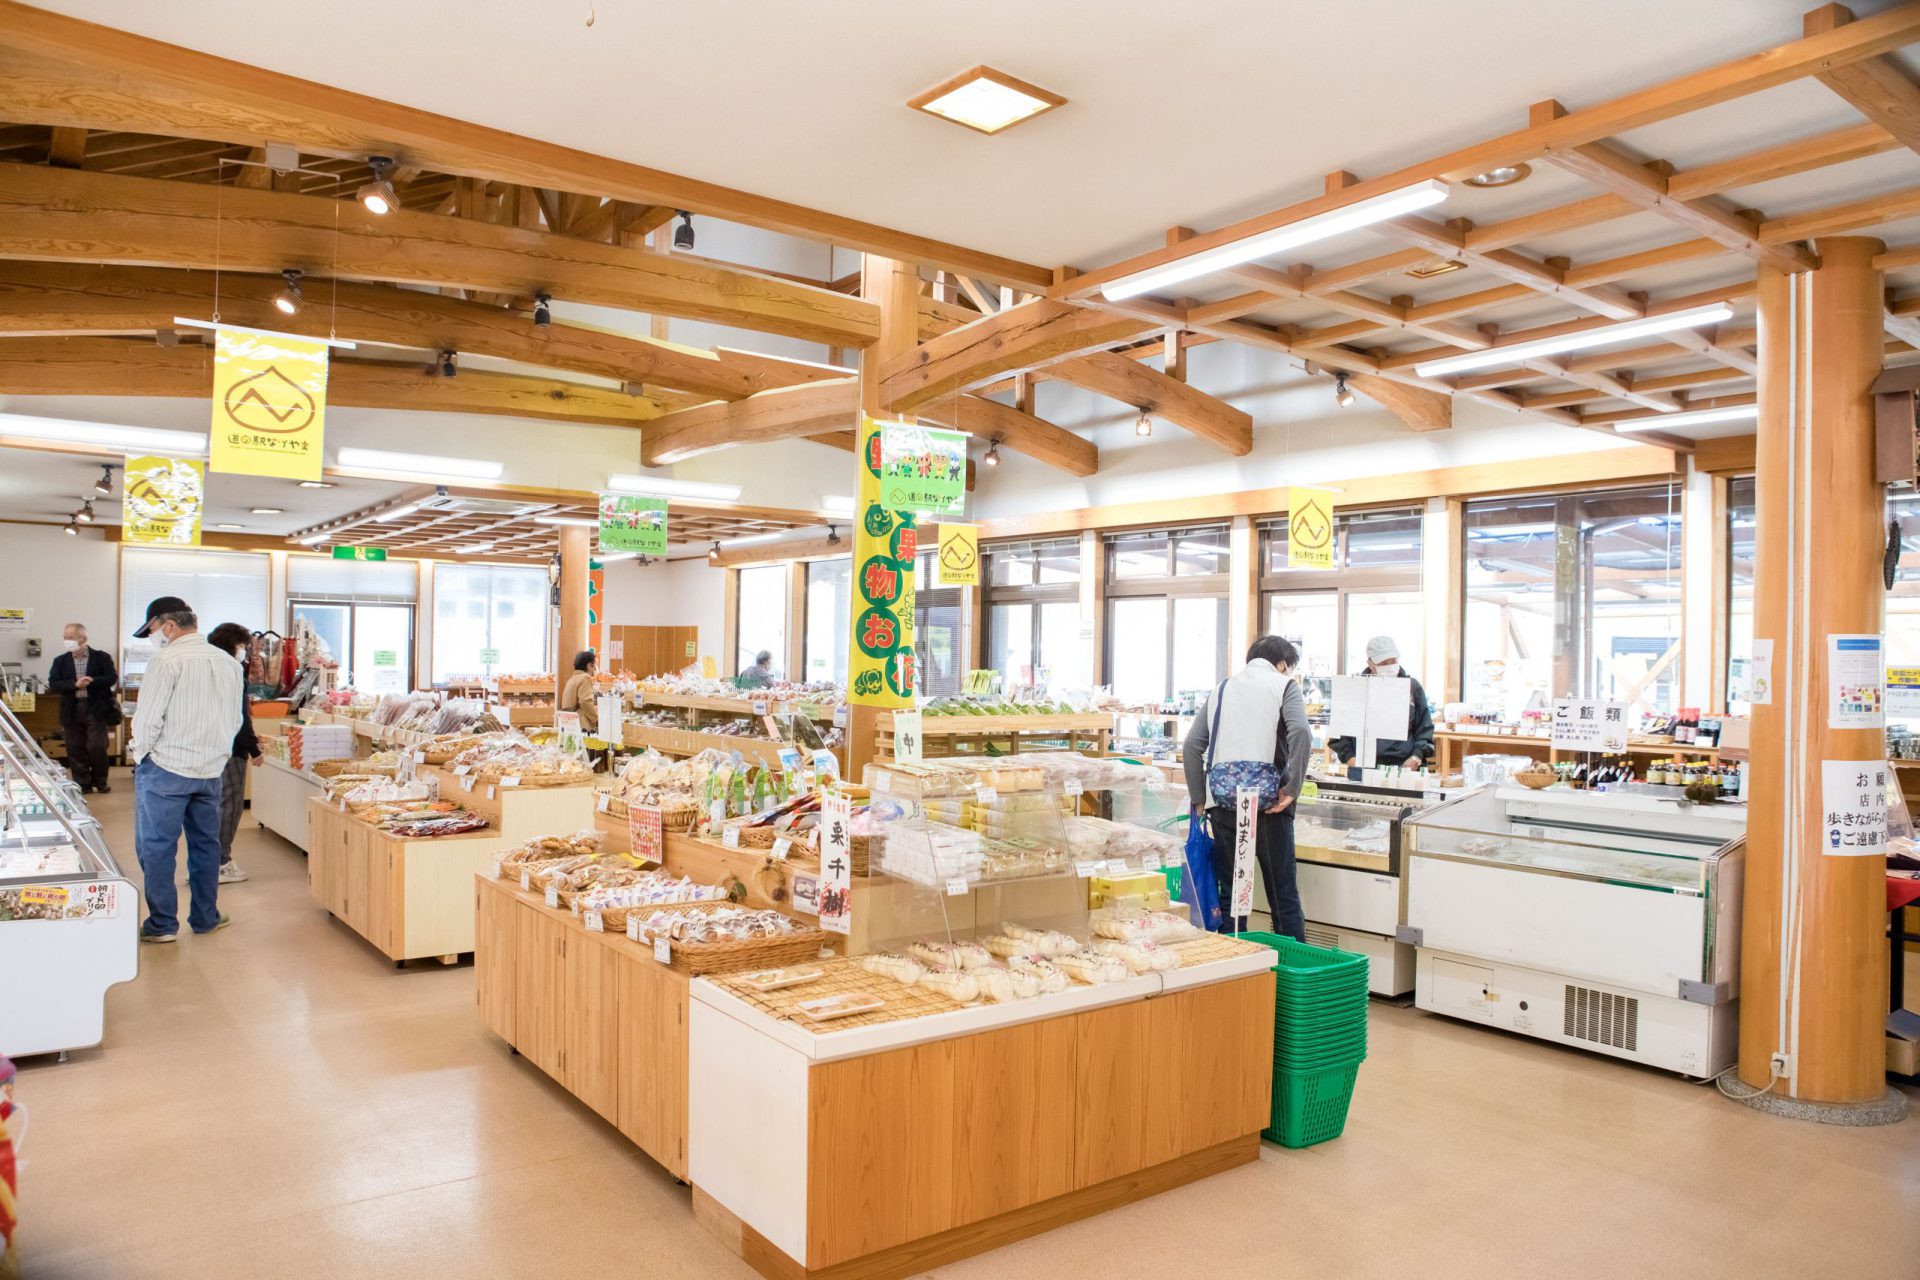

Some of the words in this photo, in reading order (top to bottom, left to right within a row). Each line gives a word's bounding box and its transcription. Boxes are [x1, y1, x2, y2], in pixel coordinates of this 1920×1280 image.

[1556, 705, 1621, 721] ご飯類
[1859, 792, 1885, 807] 店内
